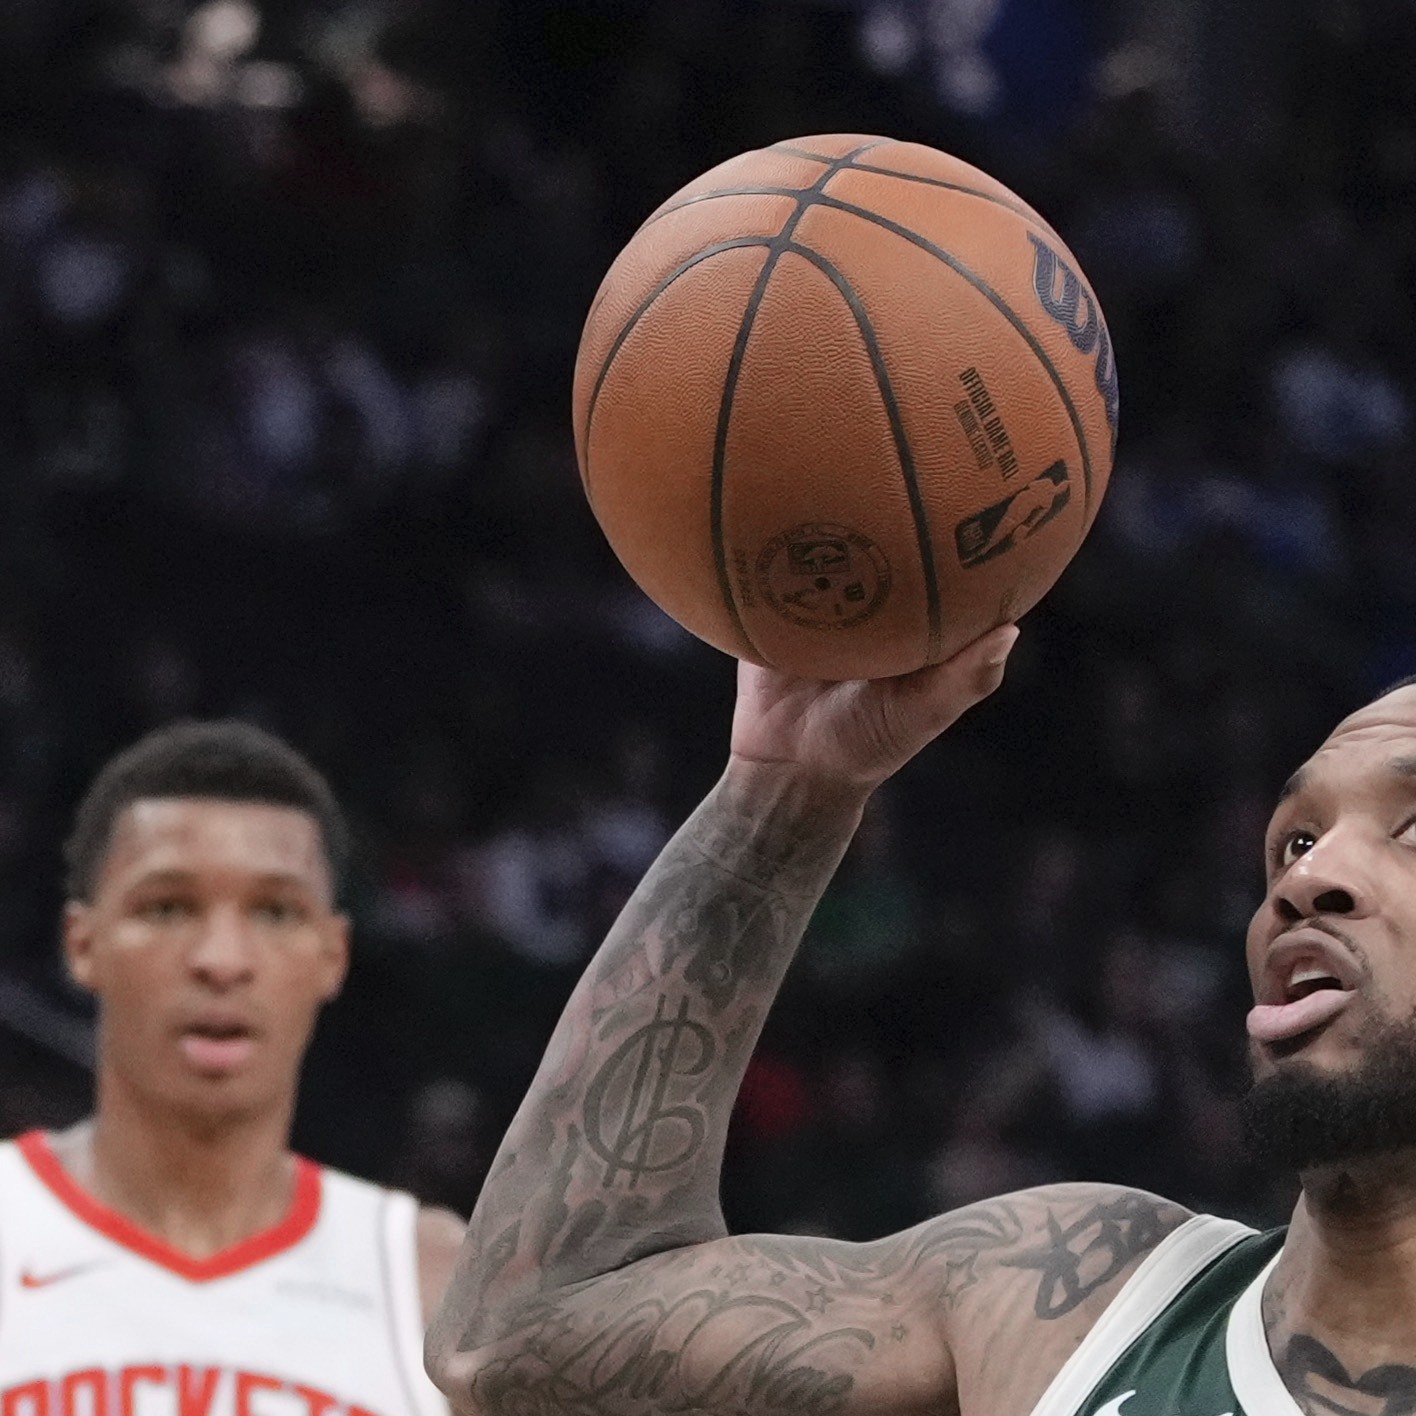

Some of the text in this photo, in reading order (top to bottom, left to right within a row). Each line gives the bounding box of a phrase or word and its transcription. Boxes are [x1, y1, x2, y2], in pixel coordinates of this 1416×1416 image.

[960, 367, 1019, 481] OFFICIAL GAME BALL
